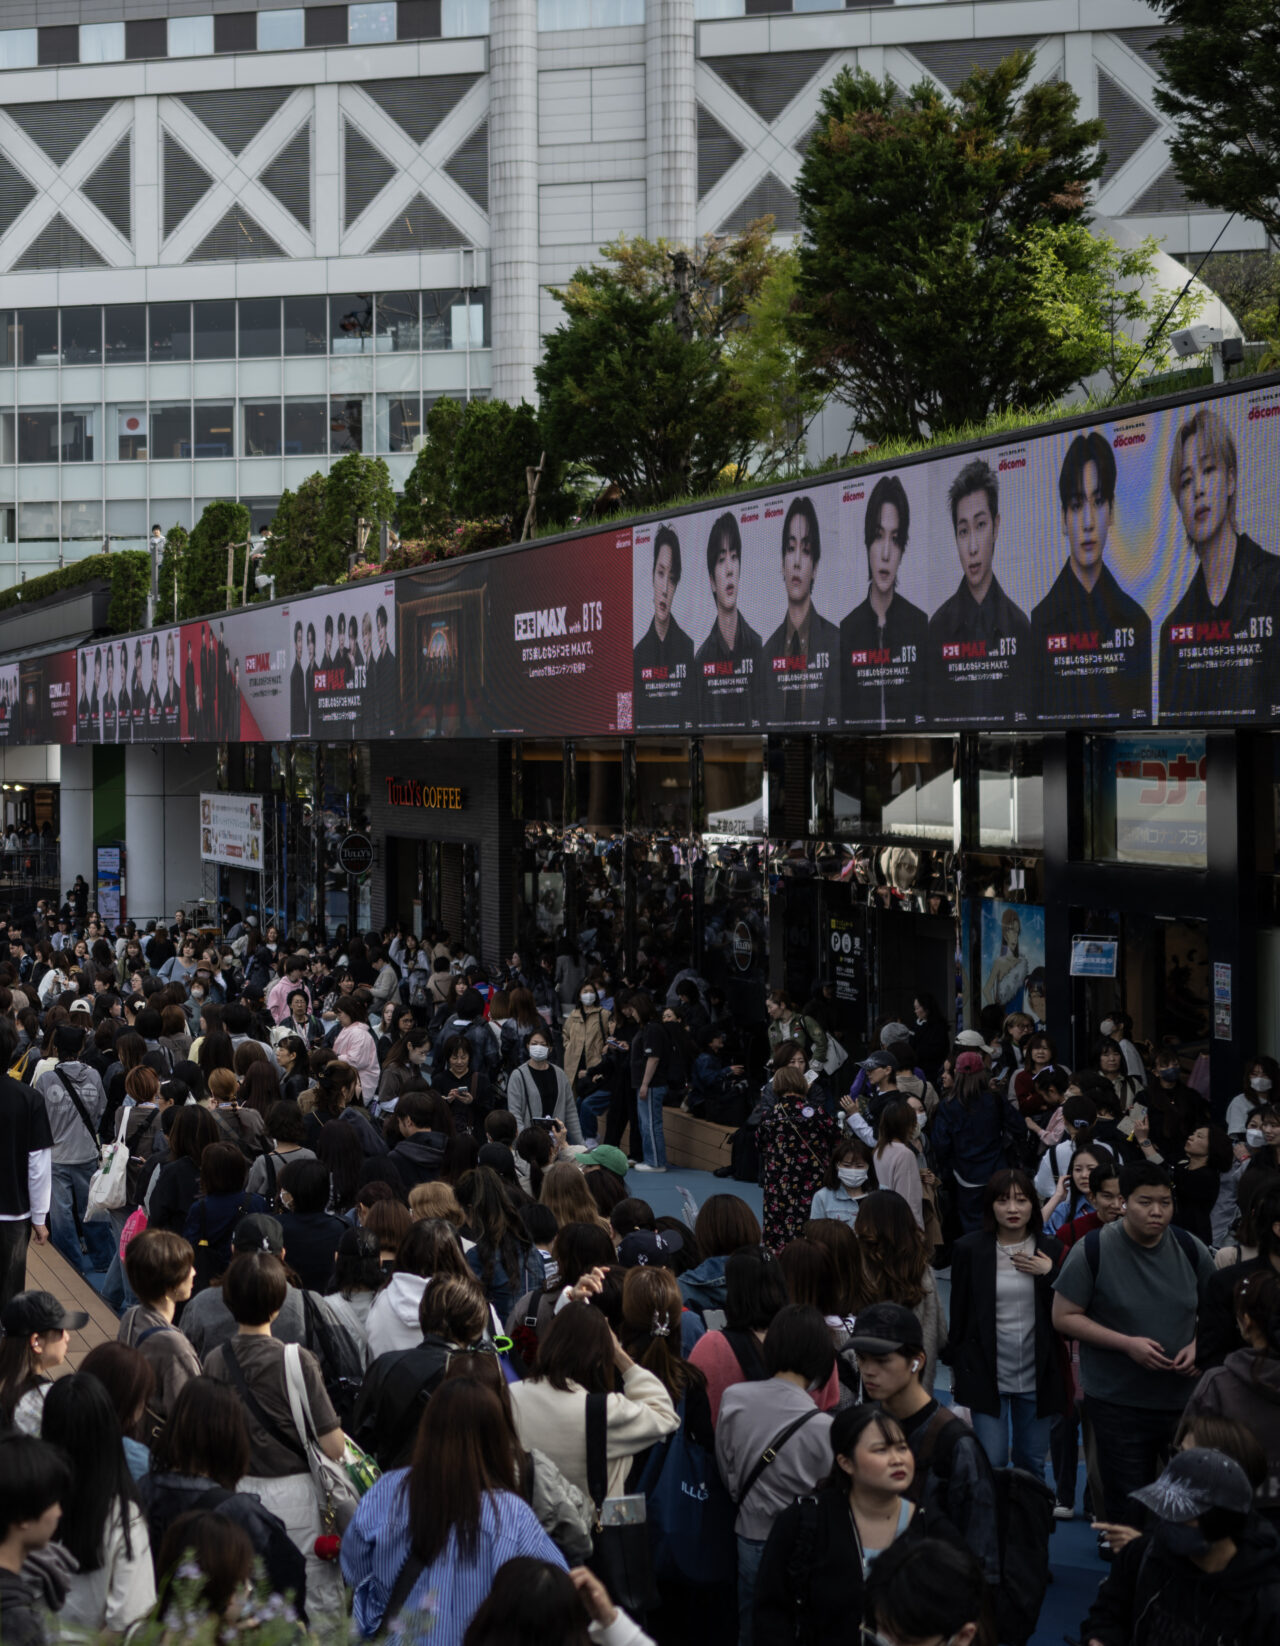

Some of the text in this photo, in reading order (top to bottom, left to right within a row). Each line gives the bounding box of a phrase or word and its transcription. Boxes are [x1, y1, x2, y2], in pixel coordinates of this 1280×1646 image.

[582, 600, 602, 632] BTS
[1250, 616, 1272, 638] BTS
[1000, 638, 1017, 656] BTS
[1114, 628, 1134, 648] BTS
[816, 652, 830, 669] BTS
[902, 646, 917, 662] BTS
[742, 658, 754, 674] BTS
[354, 665, 366, 688] BTS
[422, 786, 462, 810] COFFEE
